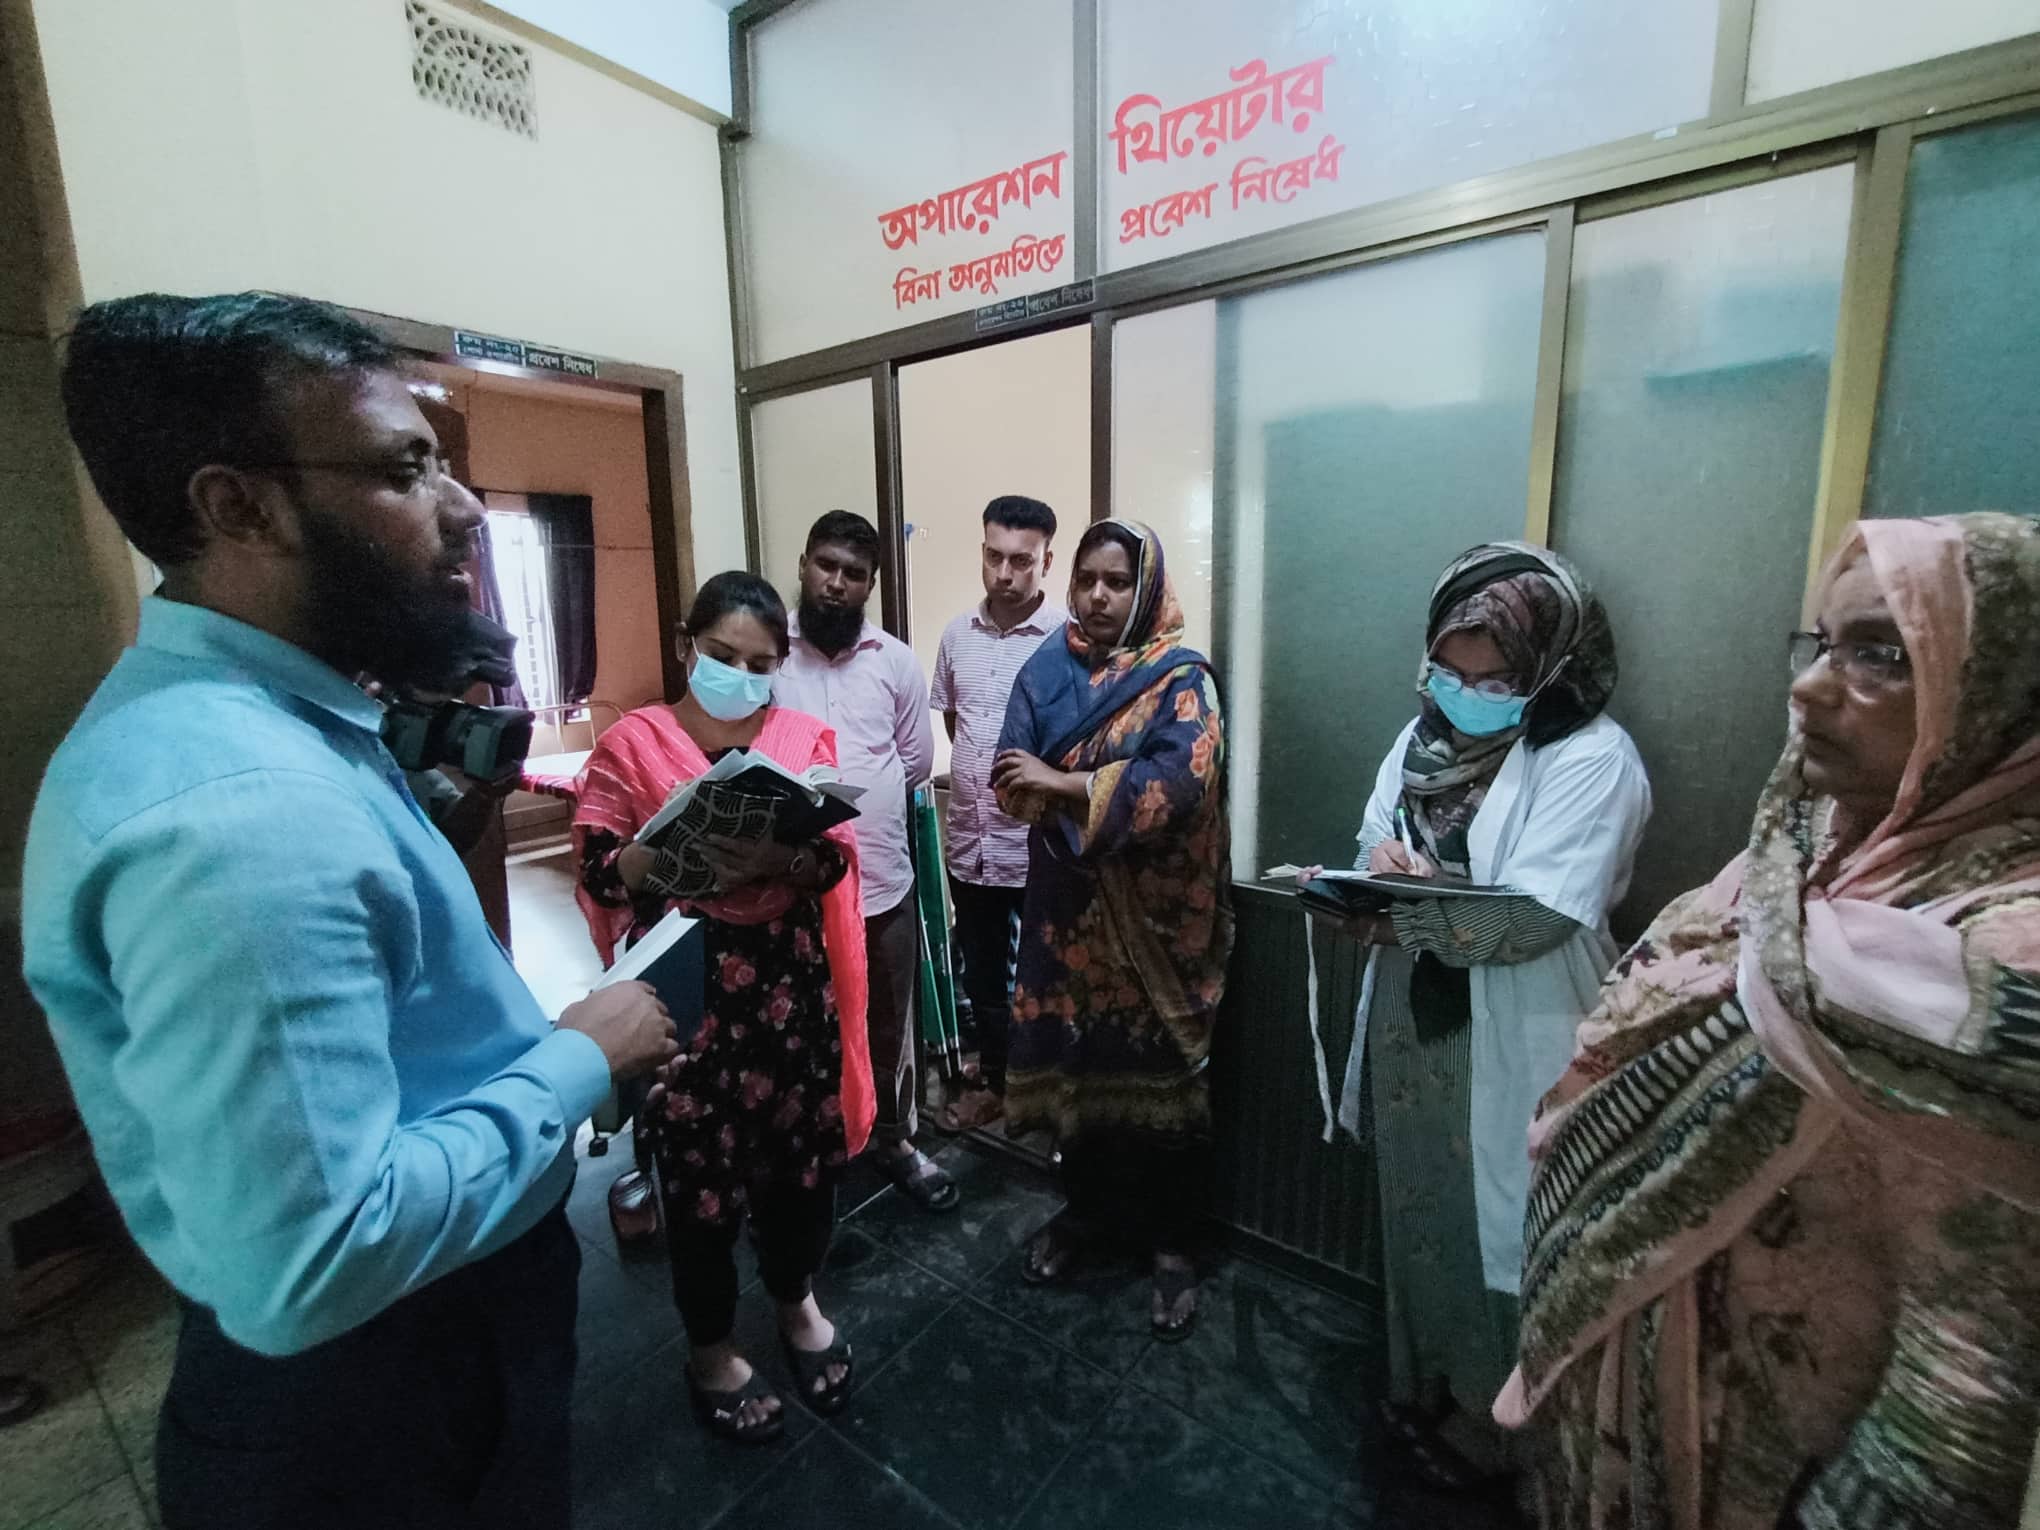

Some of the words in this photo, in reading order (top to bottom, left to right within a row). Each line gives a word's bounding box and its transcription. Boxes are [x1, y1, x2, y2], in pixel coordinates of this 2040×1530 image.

[878, 151, 1068, 251] অপারেশন
[1108, 55, 1336, 174] থিয়েটার
[893, 267, 943, 310] বিনা
[948, 233, 1066, 296] অনুমতিতে
[1119, 182, 1219, 245] প্রবেশ
[1230, 135, 1346, 210] নিষেধ
[528, 352, 560, 369] প্রবেশ
[562, 355, 594, 375] নিষেধ
